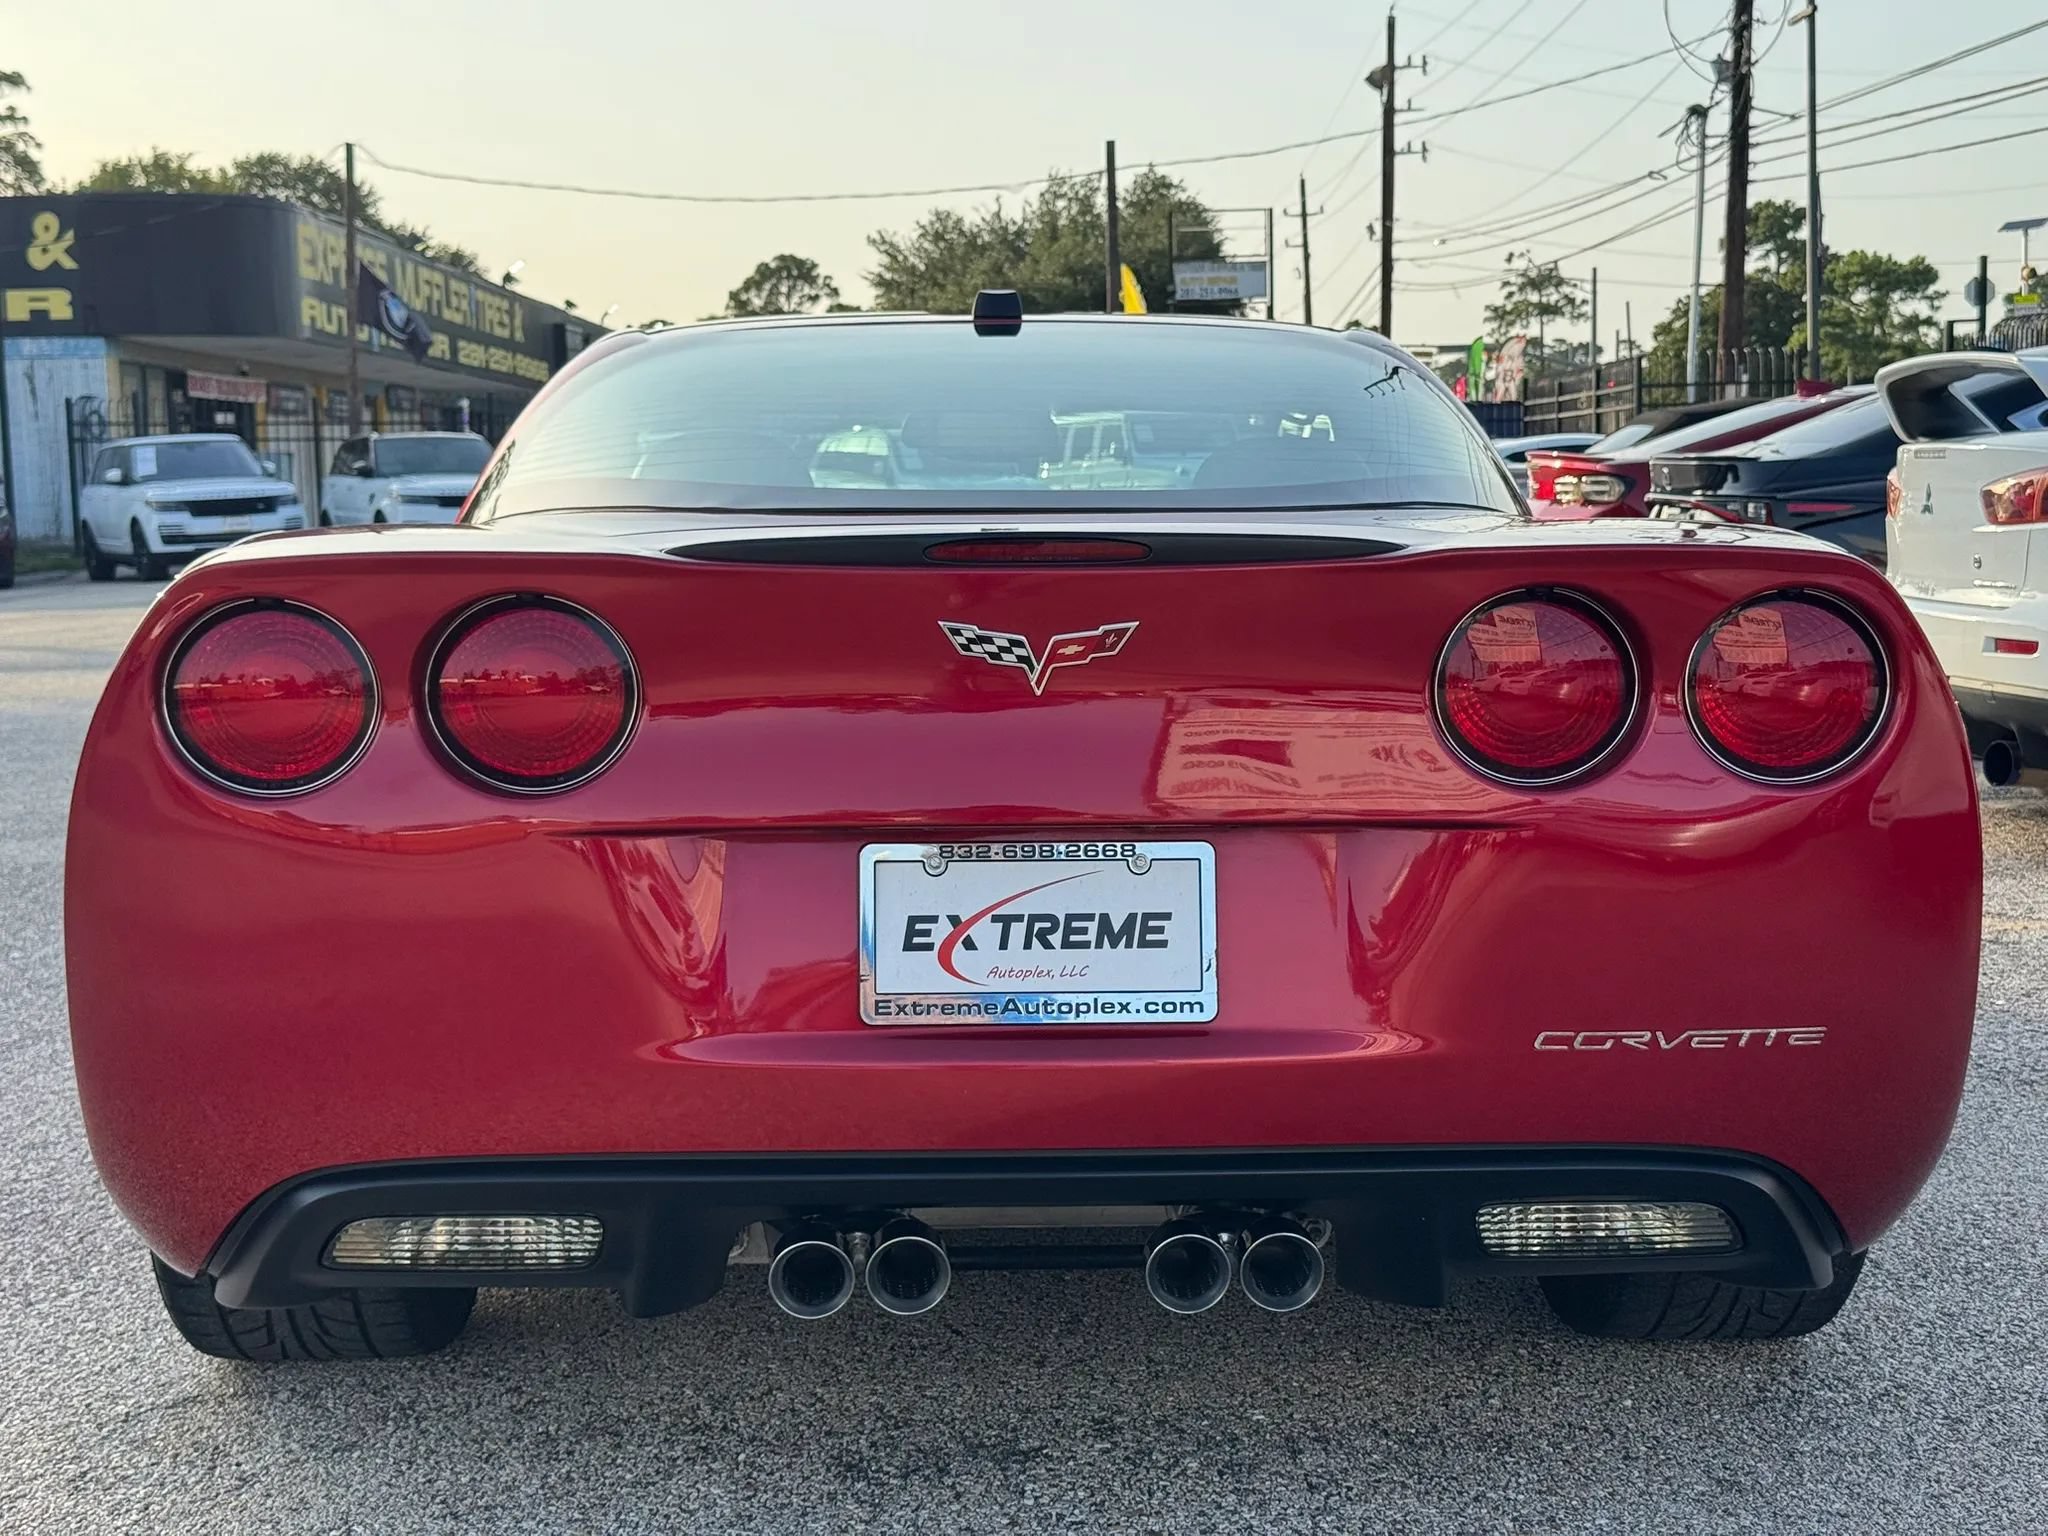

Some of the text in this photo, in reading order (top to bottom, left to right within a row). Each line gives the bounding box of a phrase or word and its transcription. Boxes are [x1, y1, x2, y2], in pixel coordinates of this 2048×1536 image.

[26, 210, 80, 271] &
[297, 224, 389, 291] EXPSS
[394, 256, 471, 329] MUFFLER
[301, 294, 371, 342] AUT
[901, 911, 1173, 952] EXTREME
[986, 964, 1091, 982] Autoplex, LLC
[873, 997, 1206, 1018] ExtremeAutoplex.com
[1533, 1025, 1828, 1051] CORVETTE
